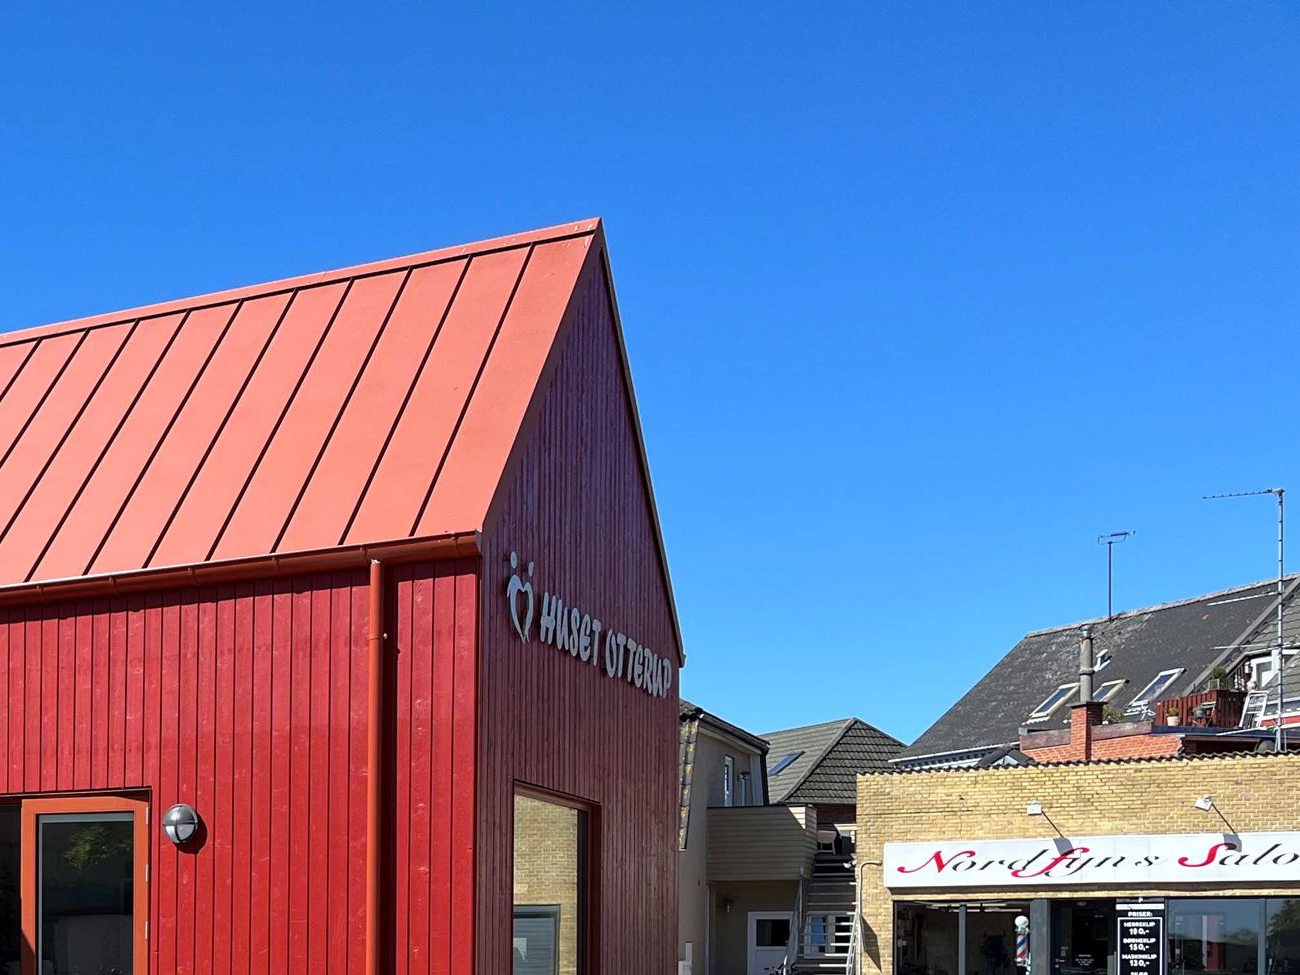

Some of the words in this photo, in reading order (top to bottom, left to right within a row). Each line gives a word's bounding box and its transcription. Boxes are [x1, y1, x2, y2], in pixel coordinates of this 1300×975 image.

[540, 592, 601, 666] HUSET
[605, 629, 672, 699] OTTERUP
[897, 847, 1161, 878] Nordfyns
